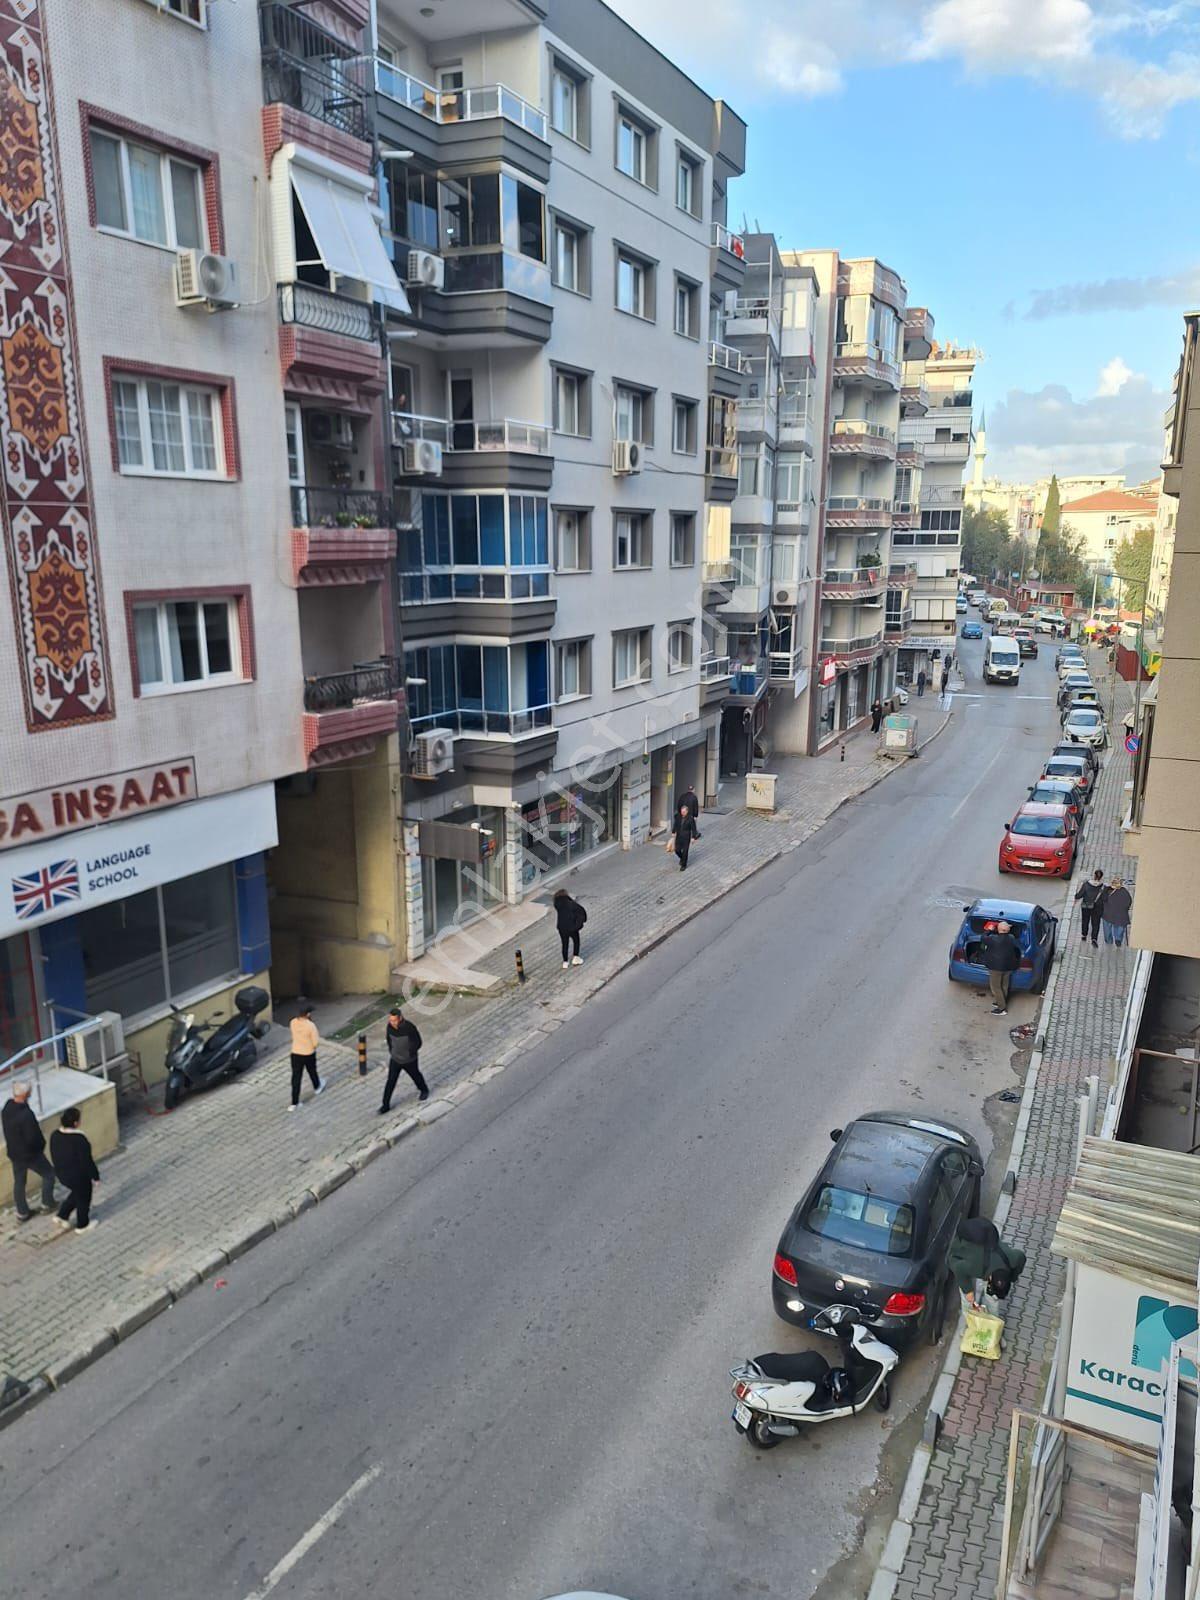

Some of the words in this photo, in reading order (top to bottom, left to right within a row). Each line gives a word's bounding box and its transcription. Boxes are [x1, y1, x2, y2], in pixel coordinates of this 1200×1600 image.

[51, 766, 191, 826] İNŞAAT
[86, 844, 151, 873] LANGUAGE
[88, 867, 139, 891] SCHOOL
